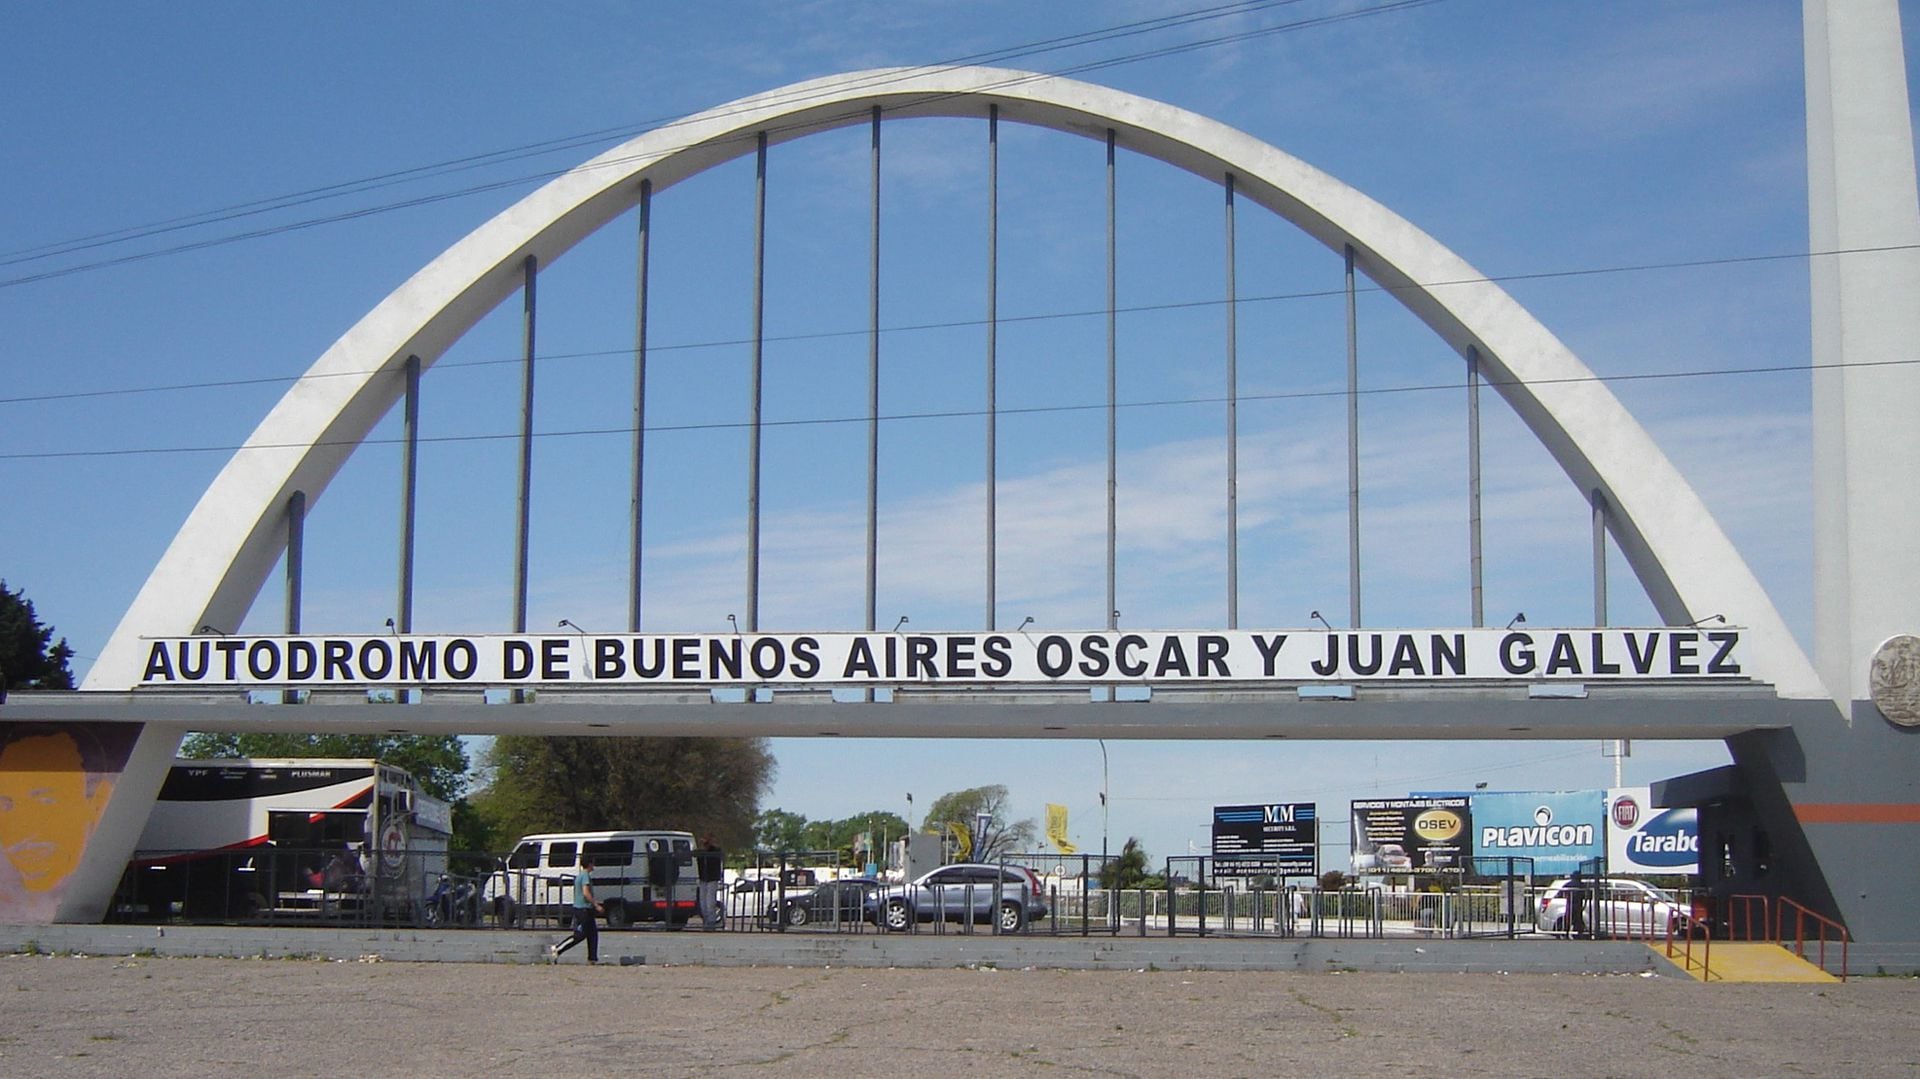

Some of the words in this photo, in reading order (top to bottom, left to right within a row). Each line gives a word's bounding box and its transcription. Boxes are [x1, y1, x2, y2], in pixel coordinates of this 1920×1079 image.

[142, 638, 478, 682] AUTODROMO
[503, 638, 570, 681] DE
[595, 636, 820, 681] BUENOS
[842, 636, 1012, 679] AIRES
[1036, 634, 1231, 679] OSCAR
[1251, 635, 1288, 678] Y
[1311, 633, 1466, 677] JUAN
[1499, 632, 1741, 676] GALVEZ
[1618, 805, 1635, 820] FIAT
[1419, 820, 1457, 829] OSEV
